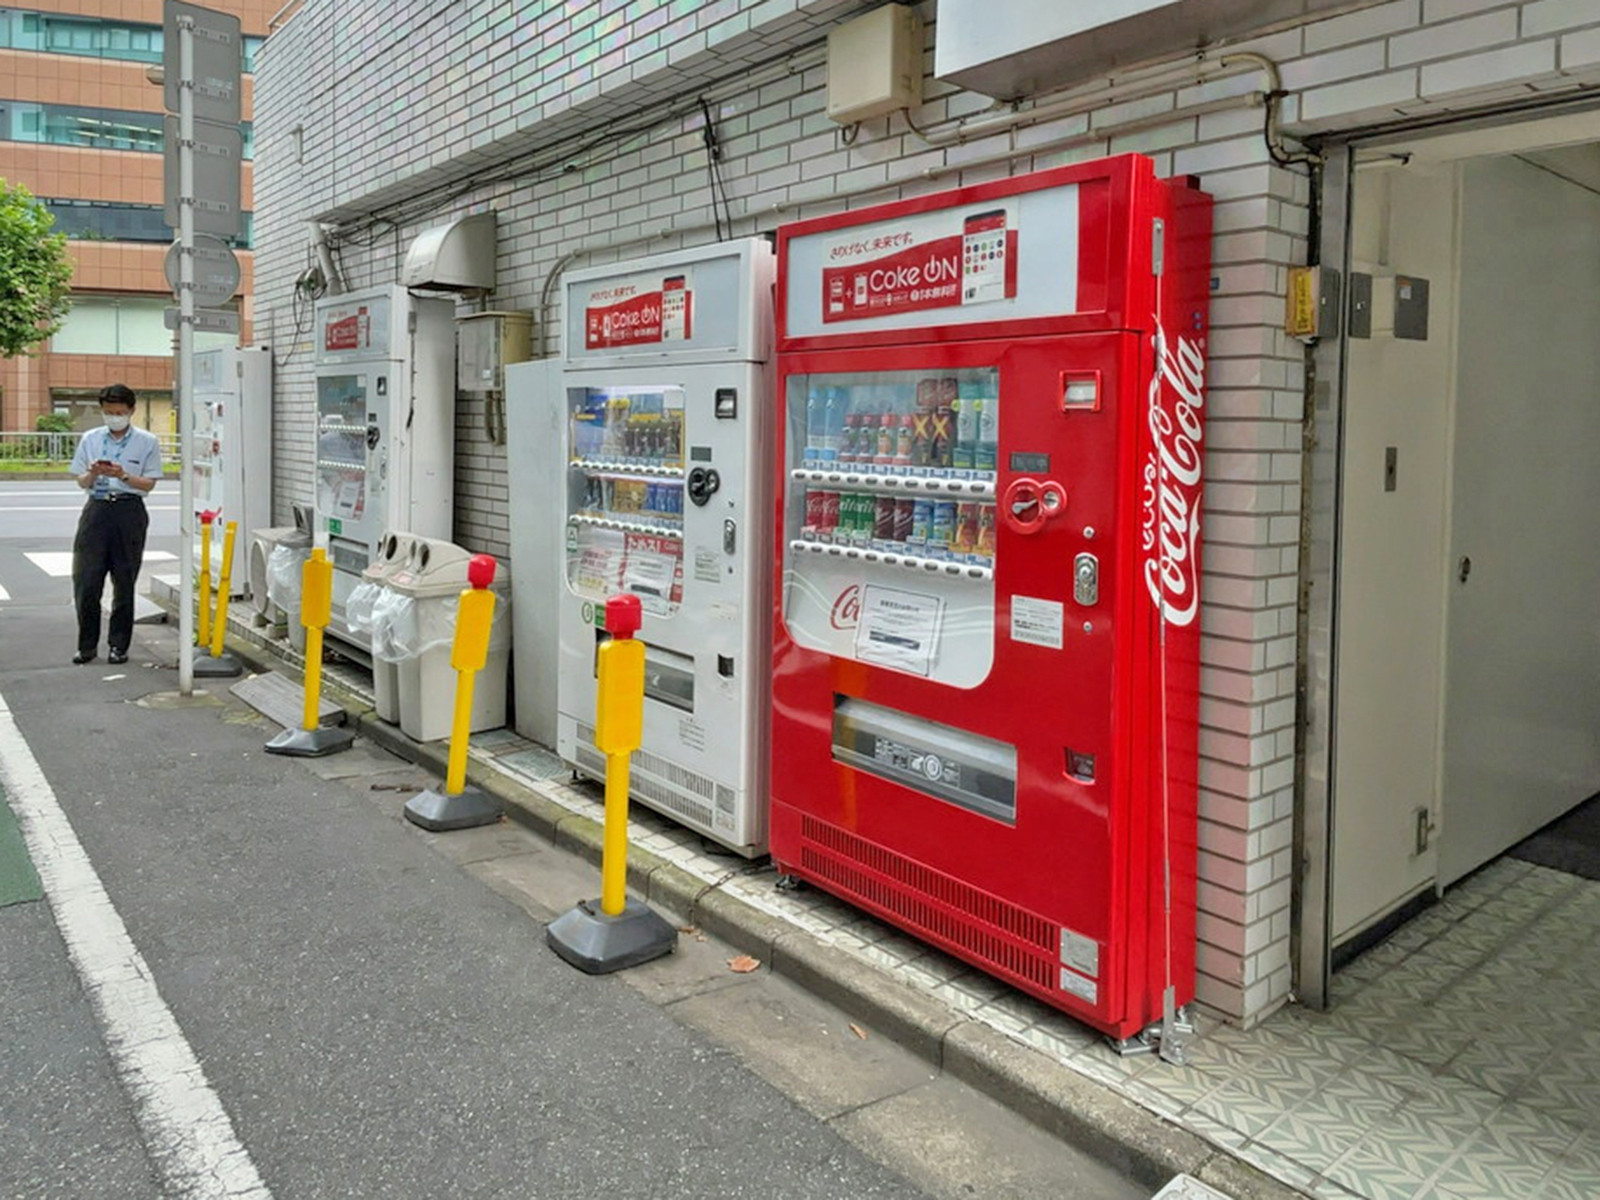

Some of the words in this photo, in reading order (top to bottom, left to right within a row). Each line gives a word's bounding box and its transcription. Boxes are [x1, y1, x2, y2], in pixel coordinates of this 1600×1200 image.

[869, 265, 920, 292] Coke
[923, 254, 958, 283] ON
[611, 310, 640, 329] Coke
[641, 303, 660, 325] ON
